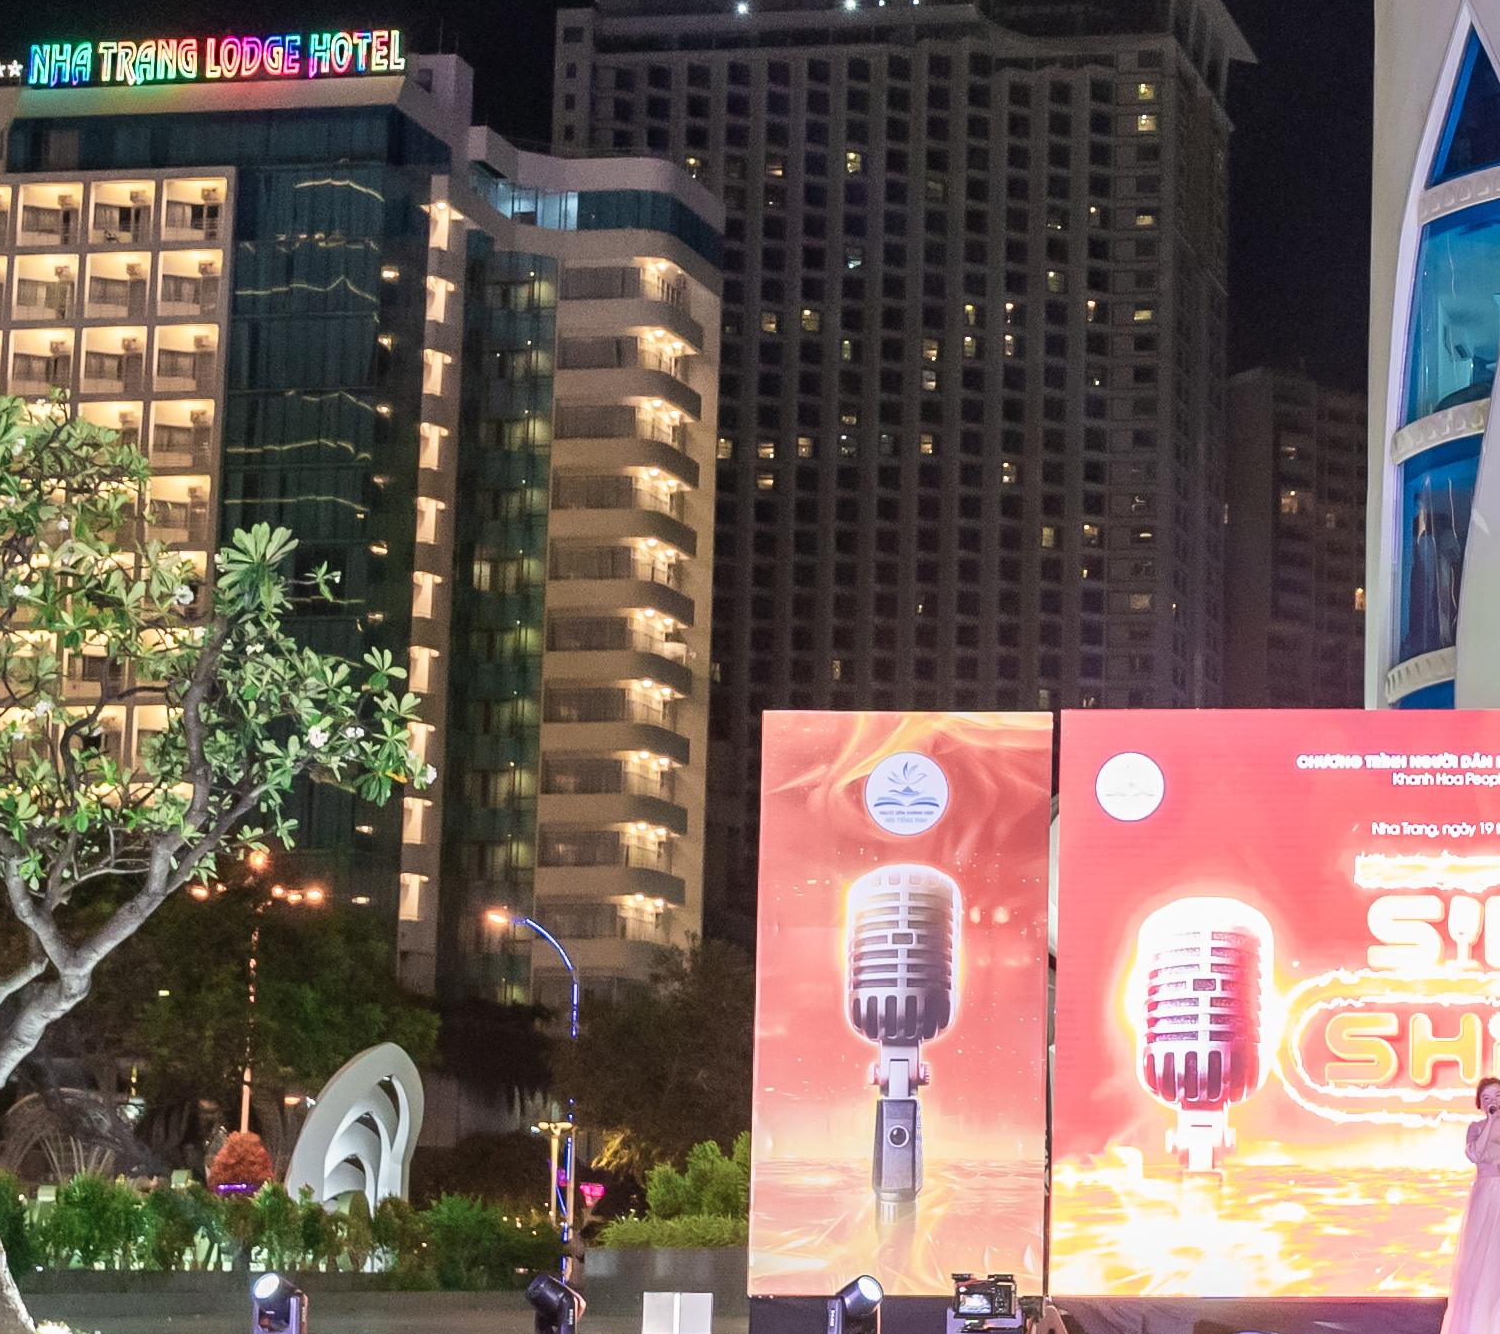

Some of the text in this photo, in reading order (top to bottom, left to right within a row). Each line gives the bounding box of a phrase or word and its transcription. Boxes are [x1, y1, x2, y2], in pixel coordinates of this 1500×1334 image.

[28, 29, 405, 87] NHA TRANG LODGE HOTEL
[1392, 771, 1434, 785] Khanh
[1436, 771, 1463, 785] Hoa
[1371, 822, 1399, 836] Nha
[1442, 821, 1476, 838] ngày
[1479, 822, 1494, 836] 19
